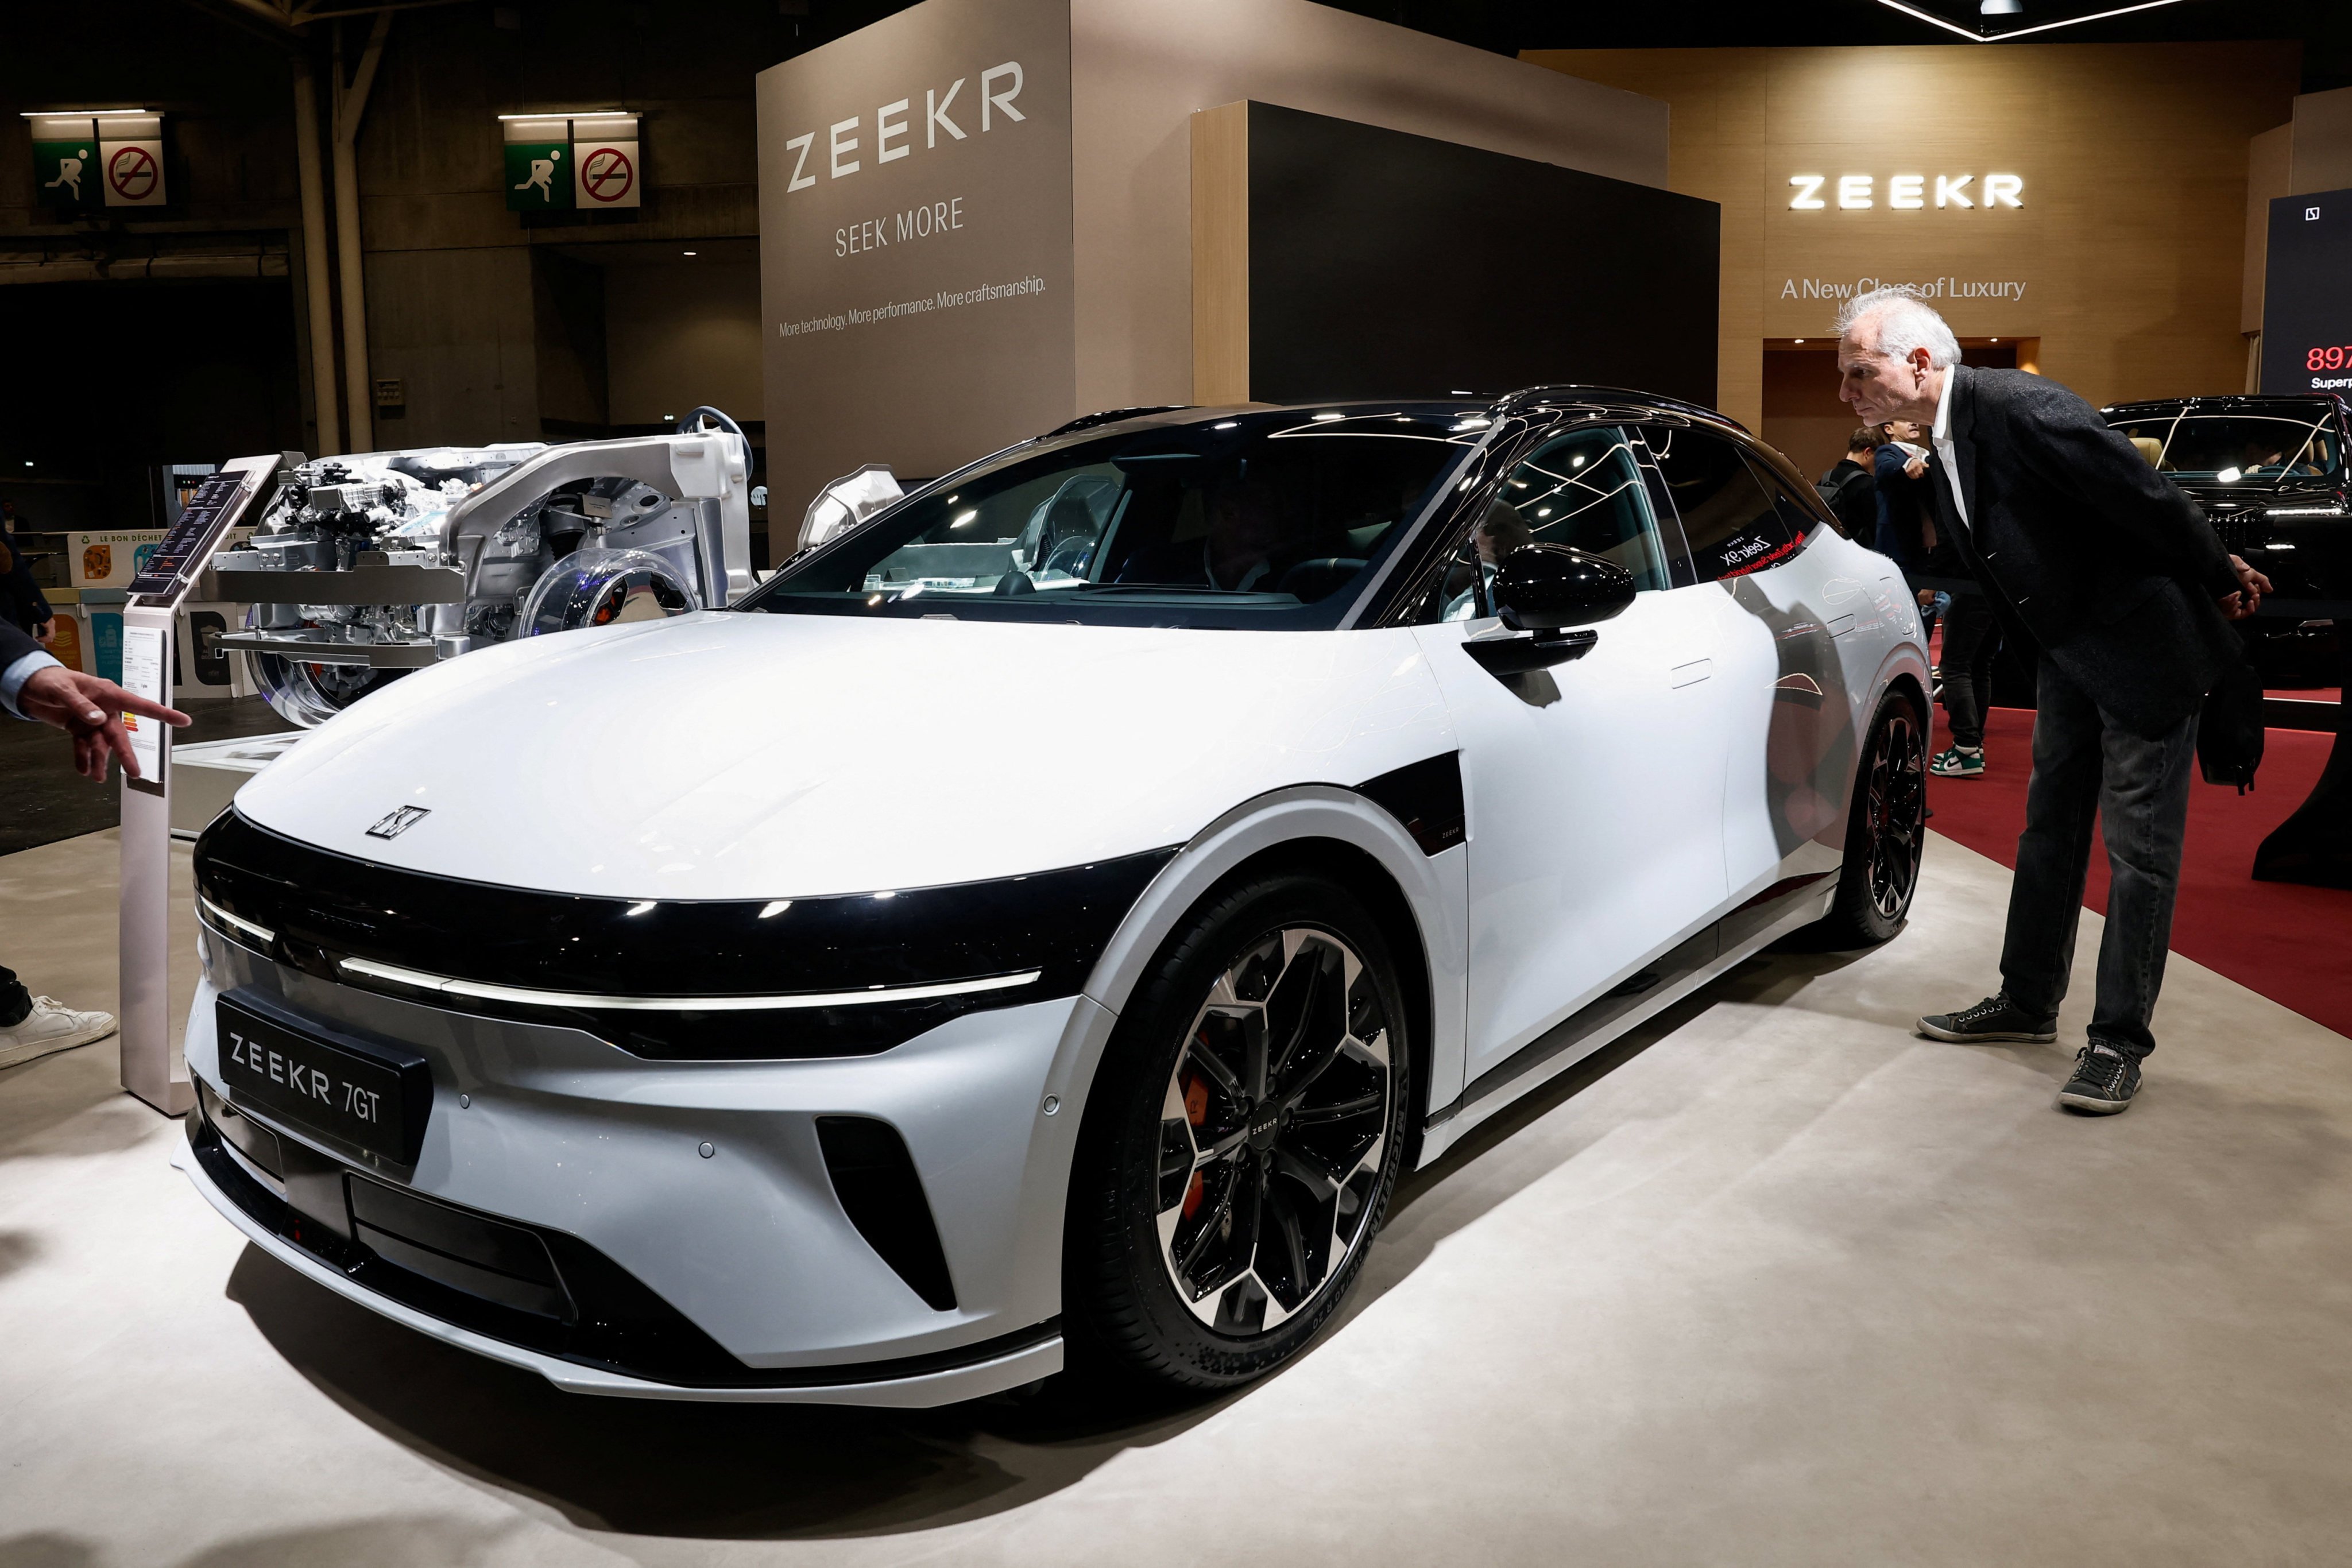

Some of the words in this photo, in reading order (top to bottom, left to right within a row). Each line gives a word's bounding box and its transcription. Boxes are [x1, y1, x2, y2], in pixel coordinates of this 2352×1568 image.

[786, 61, 1027, 193] ZEEKR
[1788, 175, 2024, 210] ZEEKR
[835, 217, 888, 257] SEEK
[896, 197, 964, 242] MORE
[780, 322, 799, 337] More
[800, 314, 848, 333] technology.
[849, 309, 871, 325] More
[873, 298, 935, 324] performance.
[937, 291, 963, 308] More
[965, 275, 1046, 303] craftsmanship.
[1781, 279, 1798, 299] A
[1803, 278, 1852, 299] New
[1921, 277, 1945, 298] of
[1950, 277, 2026, 301] Luxury
[131, 533, 162, 541] DÉCHET
[1442, 827, 1459, 839] ZEEKR
[230, 1032, 331, 1105] ZEEKR
[342, 1081, 380, 1124] 7GT
[1252, 1118, 1277, 1135] ZEEKR
[1370, 1110, 1405, 1238] MICHELIN
